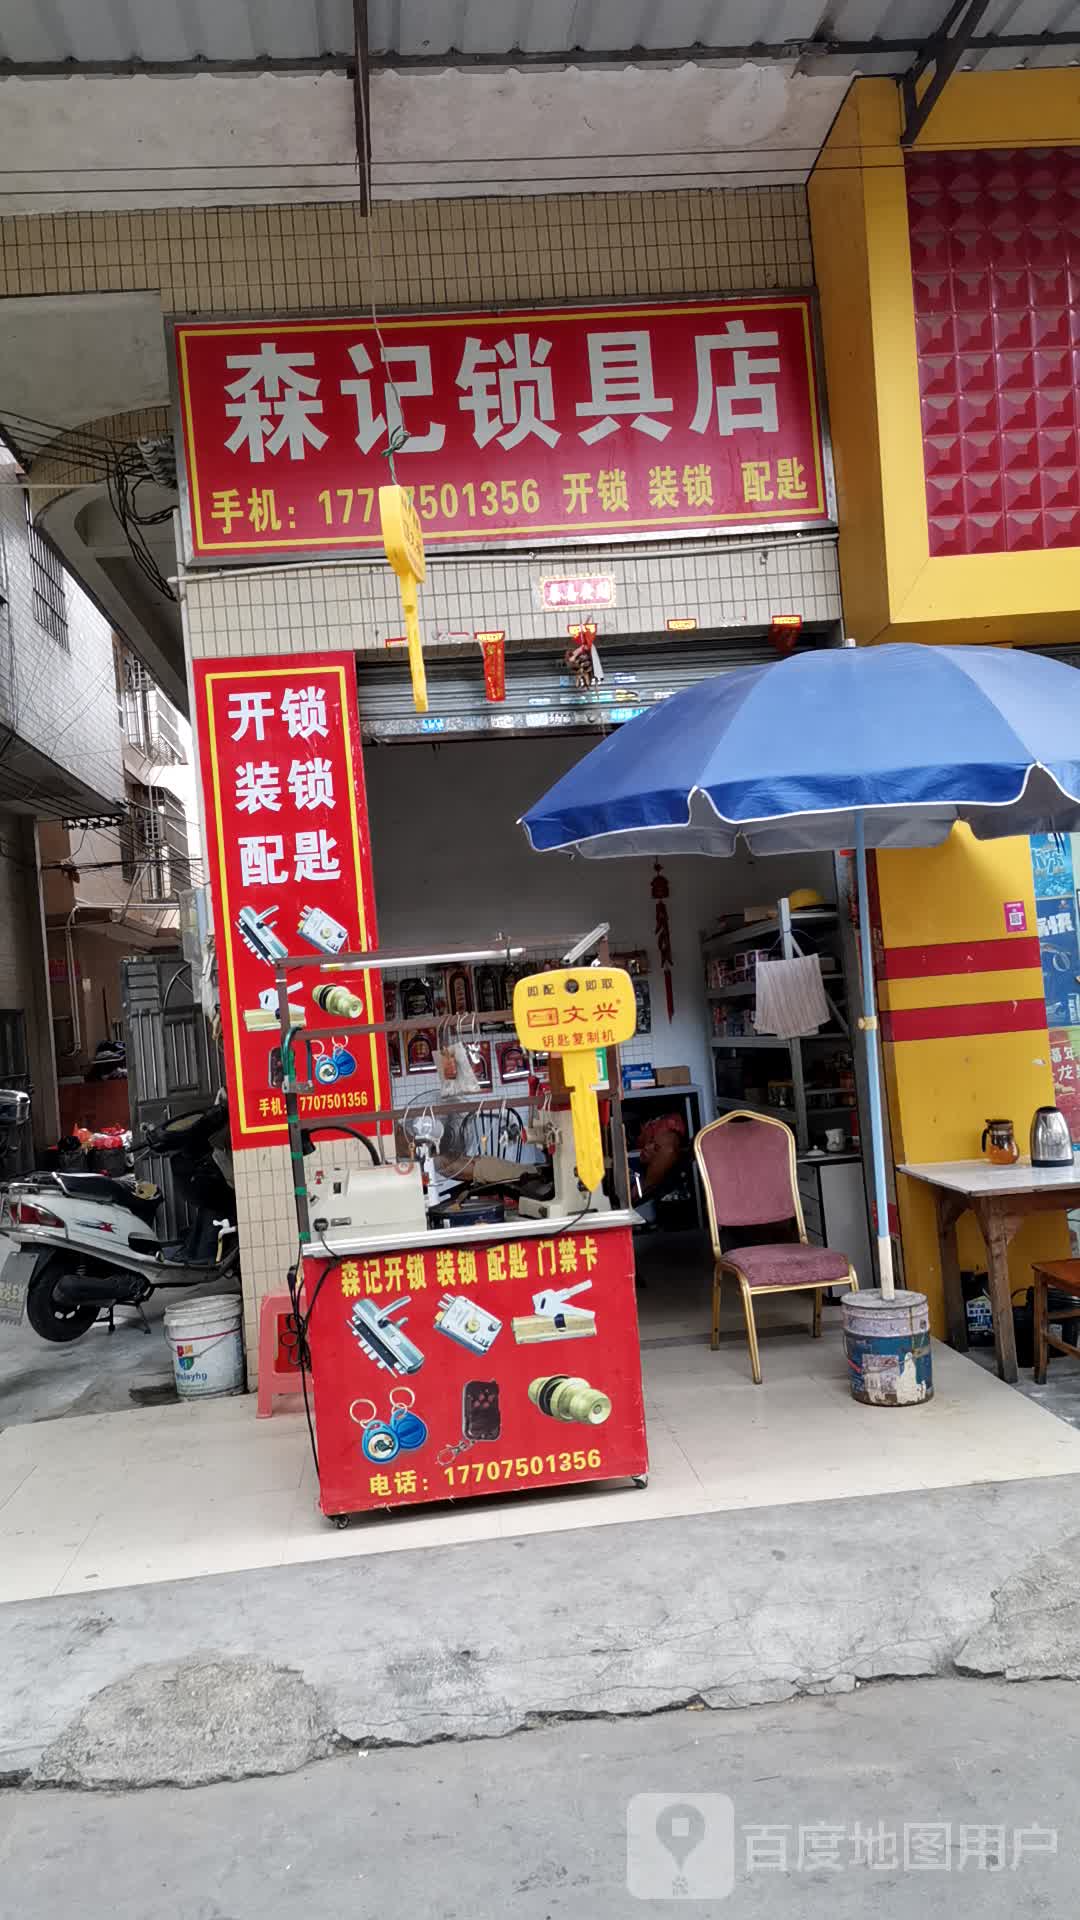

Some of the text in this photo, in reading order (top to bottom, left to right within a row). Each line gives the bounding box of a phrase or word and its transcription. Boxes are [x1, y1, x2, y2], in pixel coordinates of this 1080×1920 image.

[224, 320, 781, 463] 森记锁具店
[563, 470, 627, 513] 开锁
[649, 464, 712, 509] 装锁
[742, 458, 807, 502] 配匙
[228, 686, 329, 742] 开锁
[235, 757, 337, 815] 装锁
[238, 829, 342, 887] 配匙
[542, 1029, 615, 1048] 钥匙复制机
[562, 1002, 618, 1024] 文兴
[341, 1236, 599, 1297] 森记开锁 装锁 配匙 门禁卡
